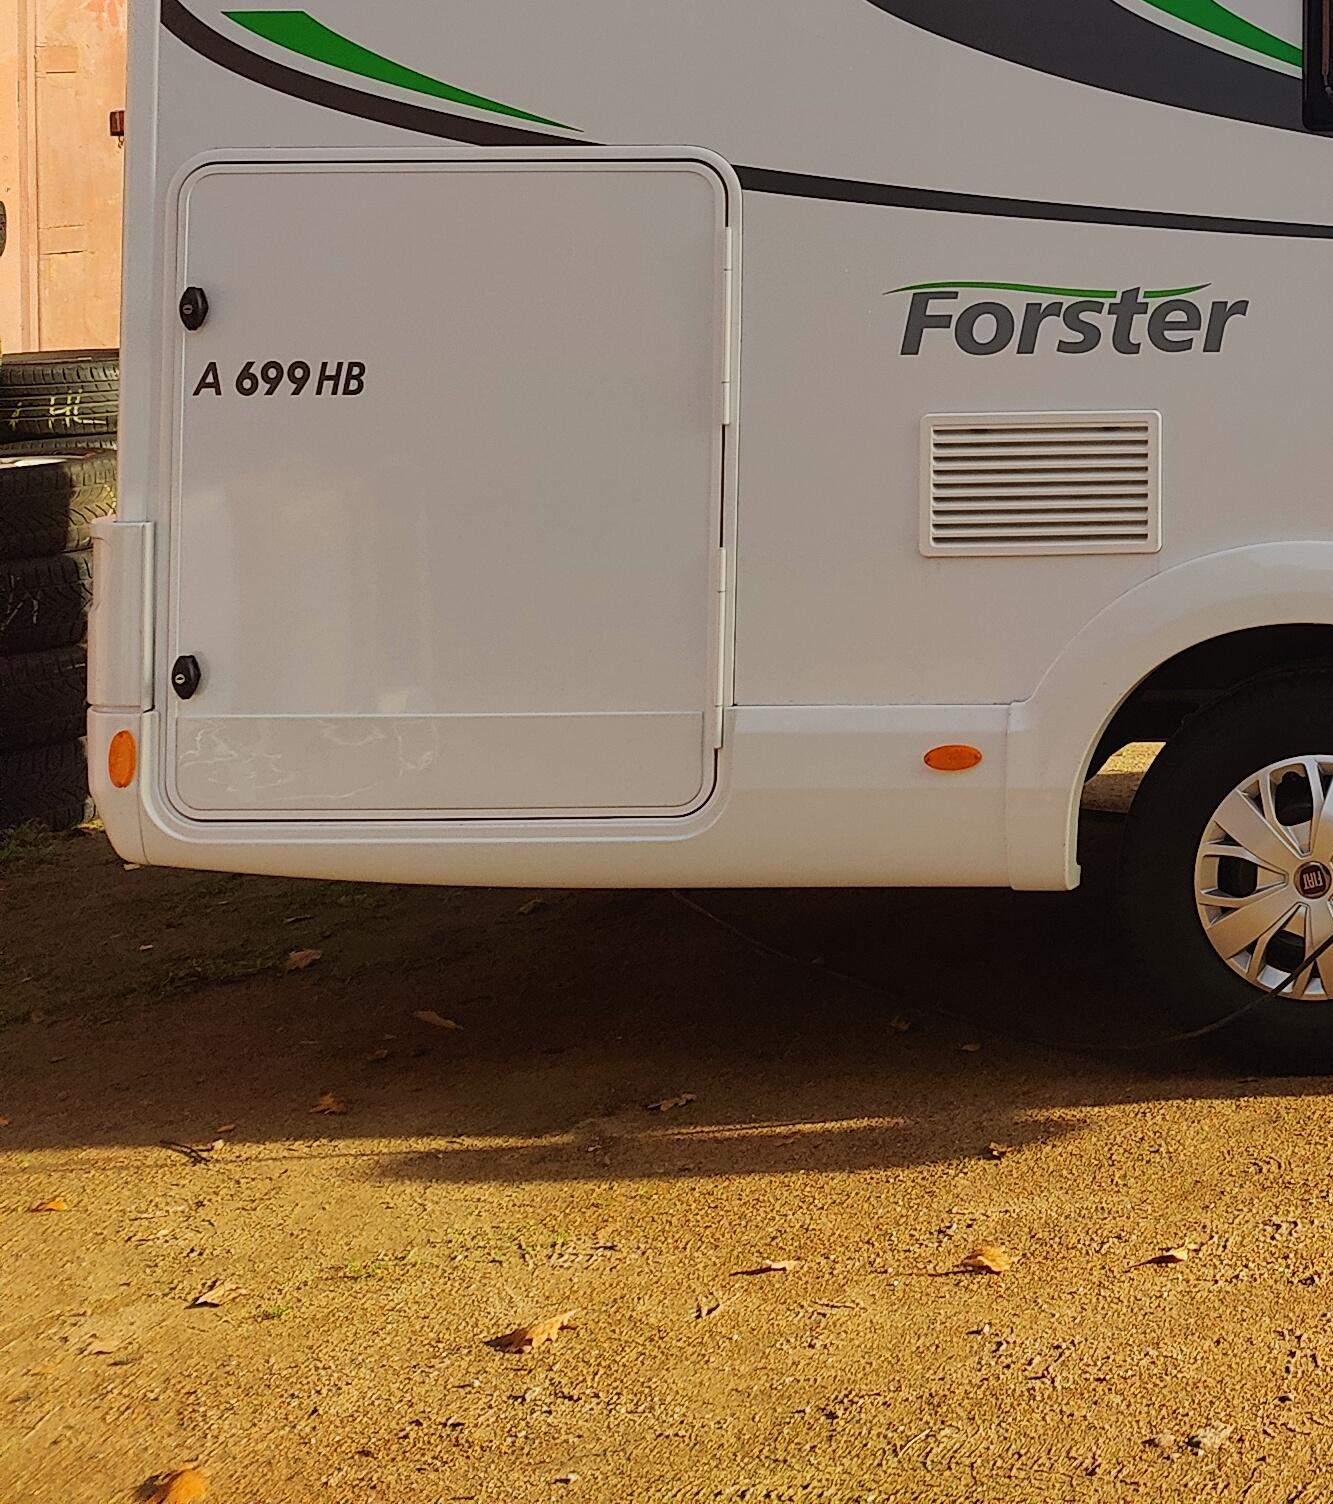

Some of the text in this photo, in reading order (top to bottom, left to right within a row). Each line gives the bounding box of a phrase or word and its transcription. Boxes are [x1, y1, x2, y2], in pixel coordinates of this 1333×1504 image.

[900, 286, 1250, 356] Forster
[192, 360, 367, 397] A 699 HB
[1302, 870, 1324, 890] FIAT
